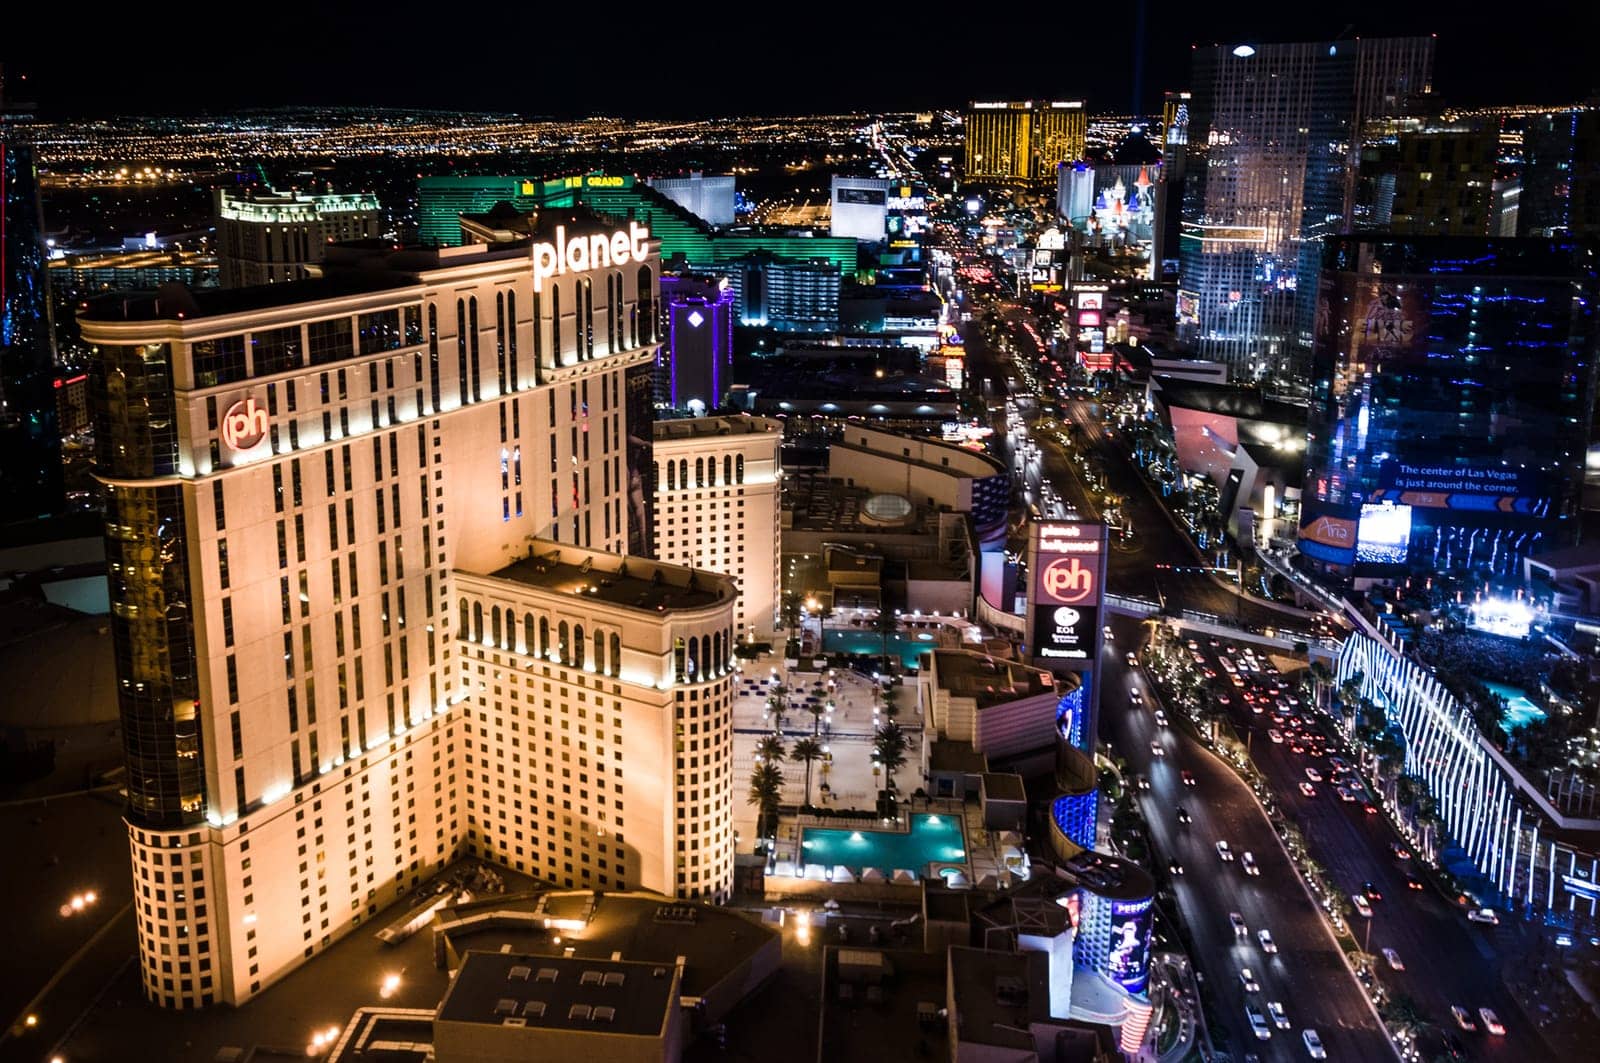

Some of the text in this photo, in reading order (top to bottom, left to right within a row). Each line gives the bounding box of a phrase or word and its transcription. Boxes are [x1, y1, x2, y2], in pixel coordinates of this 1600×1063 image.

[587, 177, 624, 187] GRAND
[533, 221, 648, 292] planet
[228, 399, 268, 448] ph
[1395, 476, 1519, 493] is just around the corner.
[1400, 465, 1518, 480] The center of Las Vegas
[1049, 558, 1092, 596] ph
